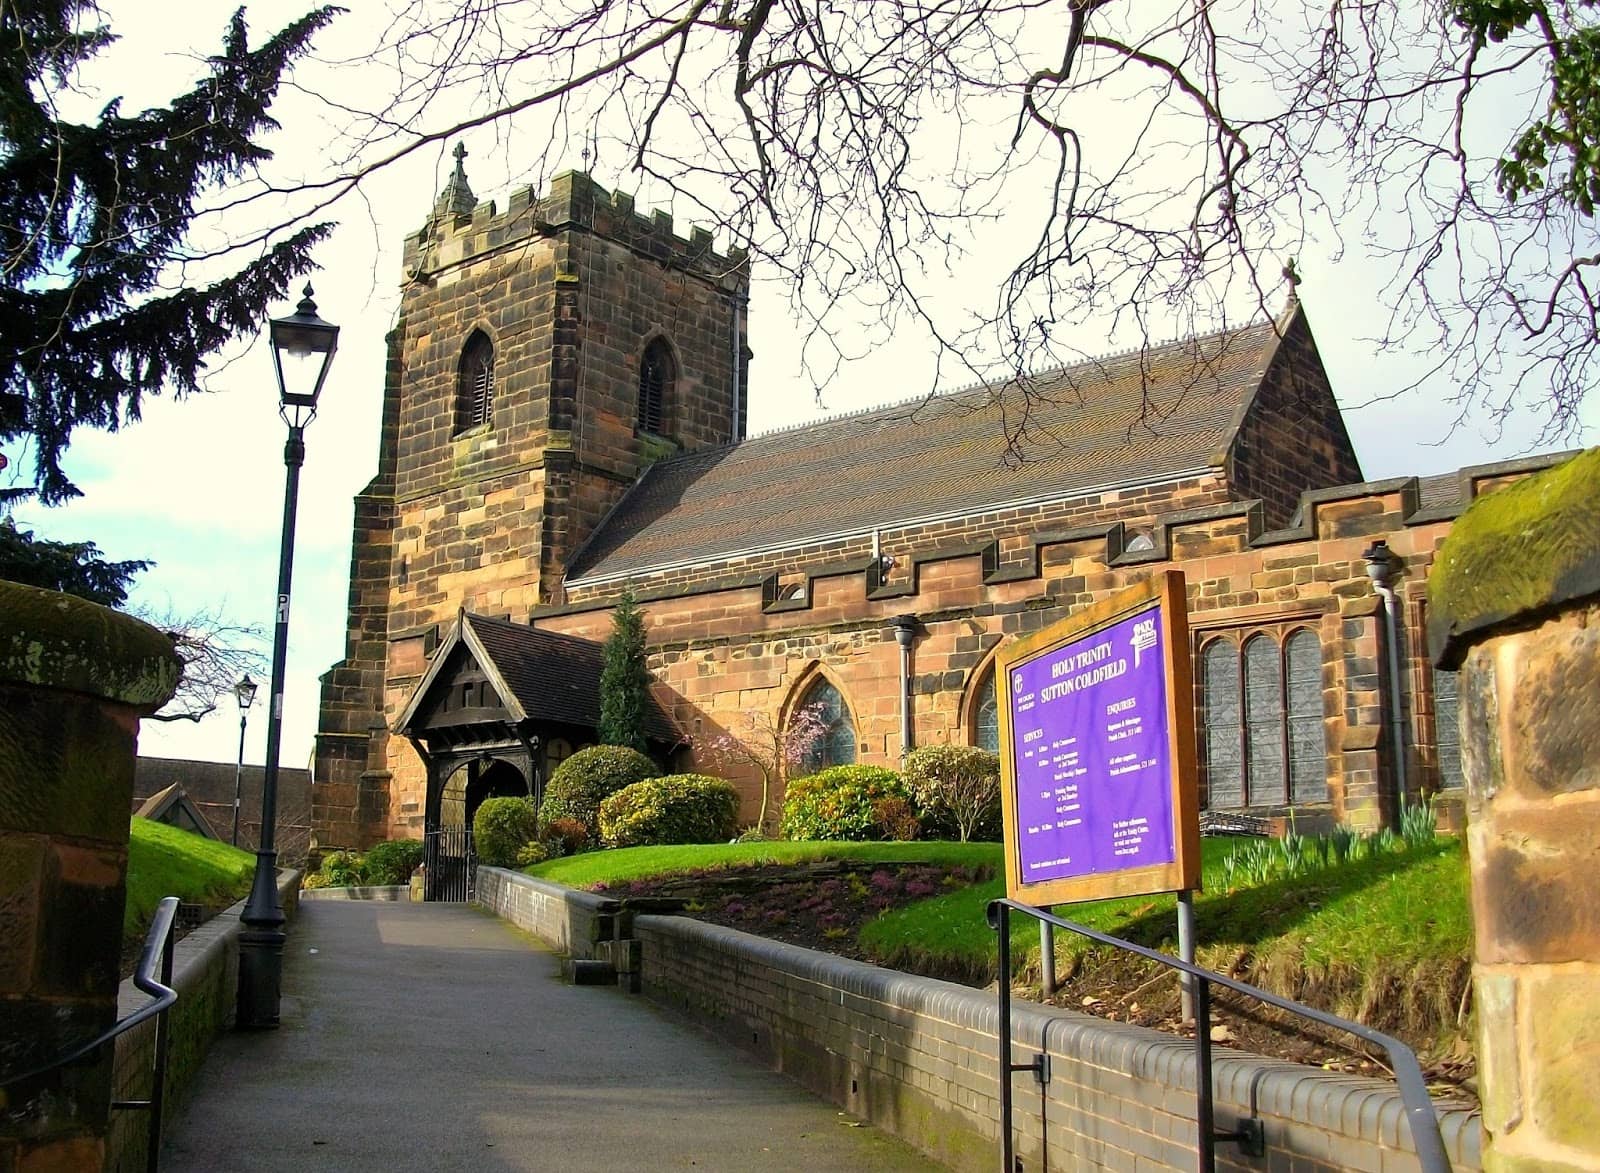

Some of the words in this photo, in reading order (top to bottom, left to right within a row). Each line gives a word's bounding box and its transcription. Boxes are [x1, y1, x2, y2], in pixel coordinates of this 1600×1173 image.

[278, 595, 288, 608] P
[1052, 656, 1077, 679] HOLY
[1077, 641, 1113, 669] TRINITY
[1041, 679, 1075, 704] SUTTON
[1075, 659, 1127, 691] COLDFIELD
[1107, 697, 1136, 715] ENQUIRIES
[1024, 728, 1043, 743] SERVICES
